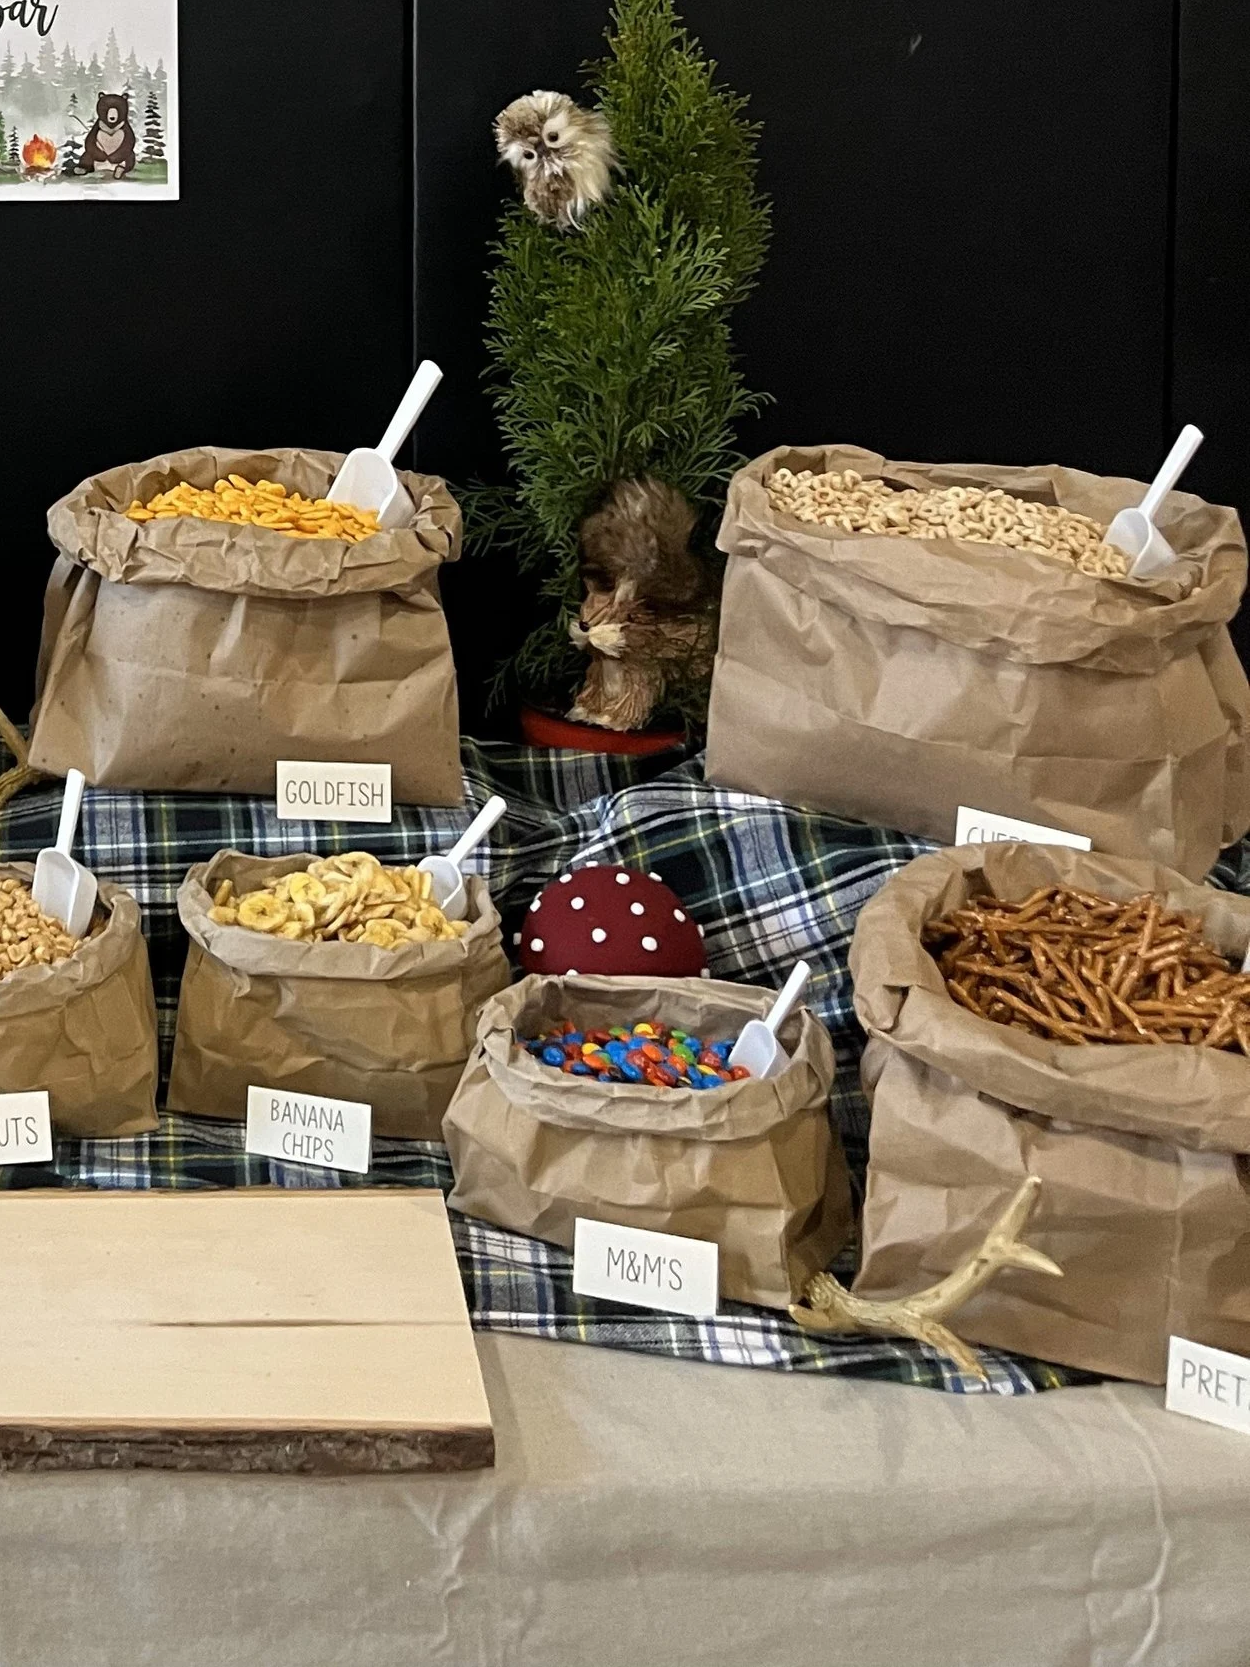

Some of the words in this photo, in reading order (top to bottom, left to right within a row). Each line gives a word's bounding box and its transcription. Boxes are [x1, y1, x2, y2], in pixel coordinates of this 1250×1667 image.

[285, 780, 384, 807] GOLDFISH
[270, 1098, 345, 1133] BANANA
[282, 1132, 334, 1162] CHIPS
[607, 1247, 682, 1291] M&M'S
[1181, 1358, 1250, 1410] PRET
